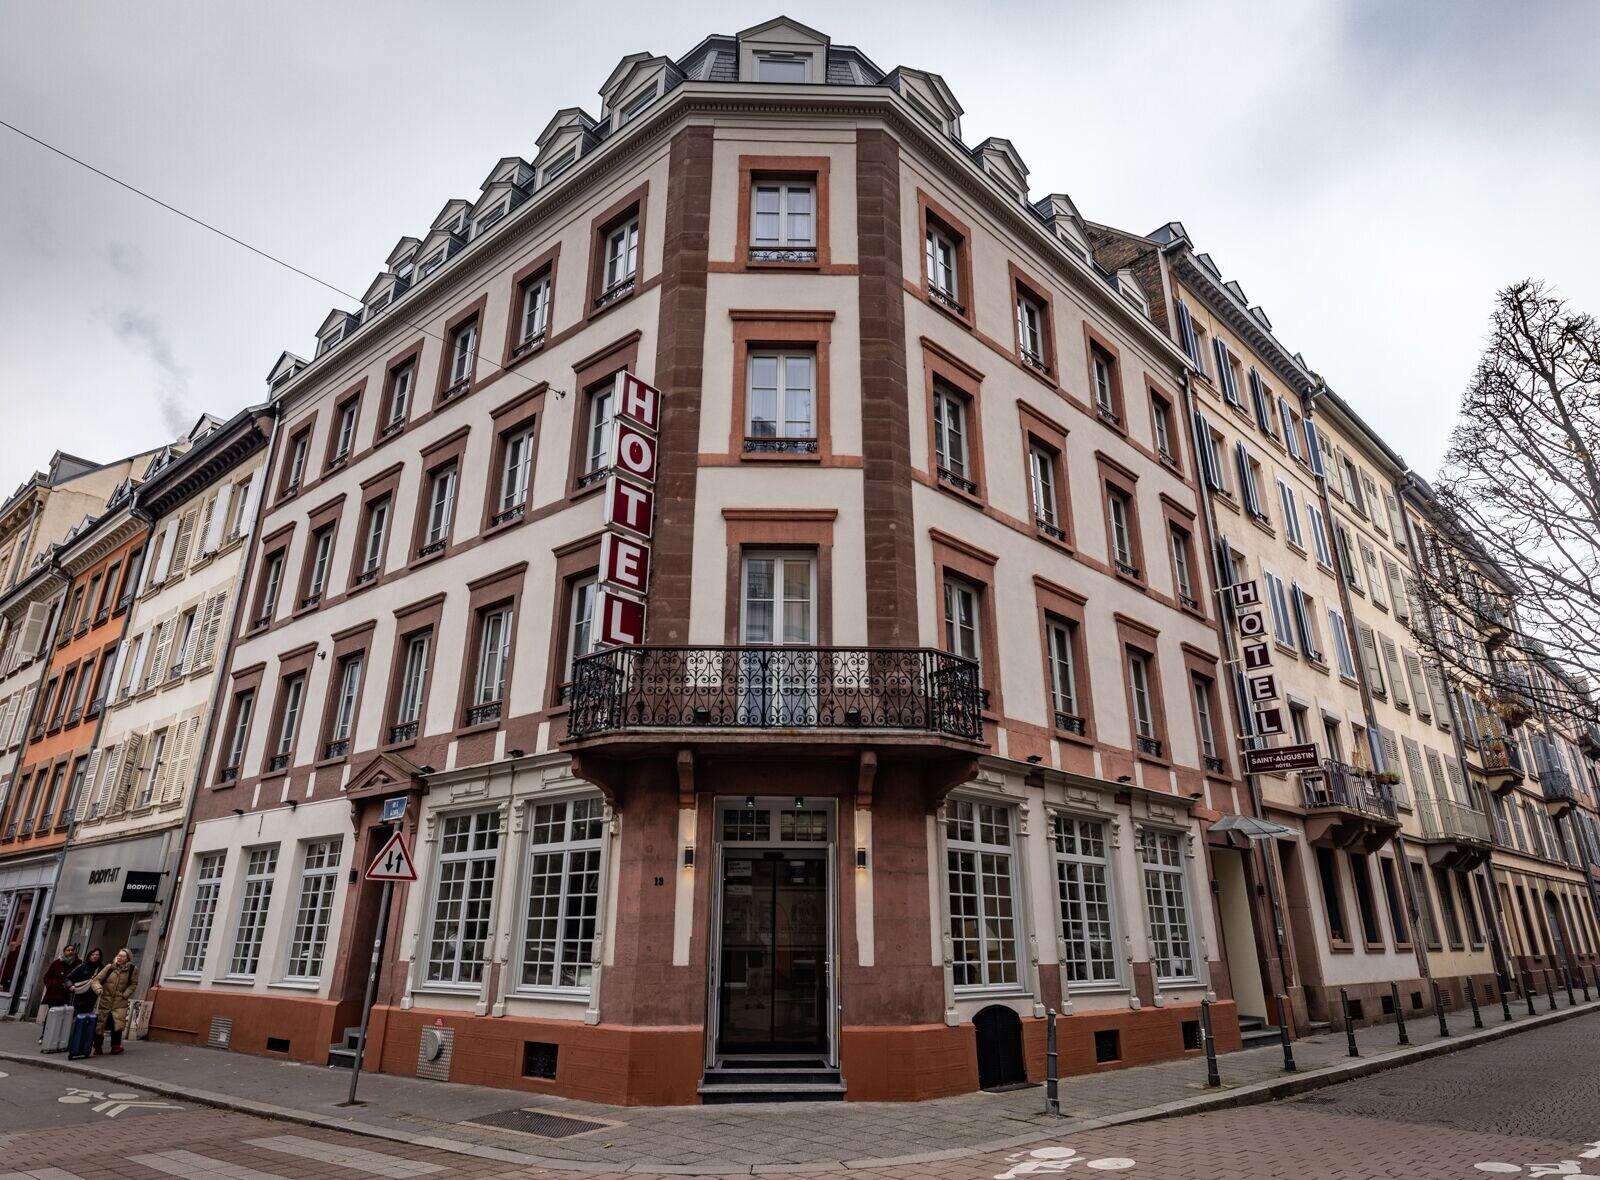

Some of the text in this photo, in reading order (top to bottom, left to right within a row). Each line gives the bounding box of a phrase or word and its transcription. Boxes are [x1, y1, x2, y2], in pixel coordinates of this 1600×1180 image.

[610, 380, 655, 645] HOTEL
[1235, 582, 1278, 733] HOTEL
[1251, 752, 1315, 764] SAINT-AUGUSTIN
[88, 867, 121, 885] BODYHIT
